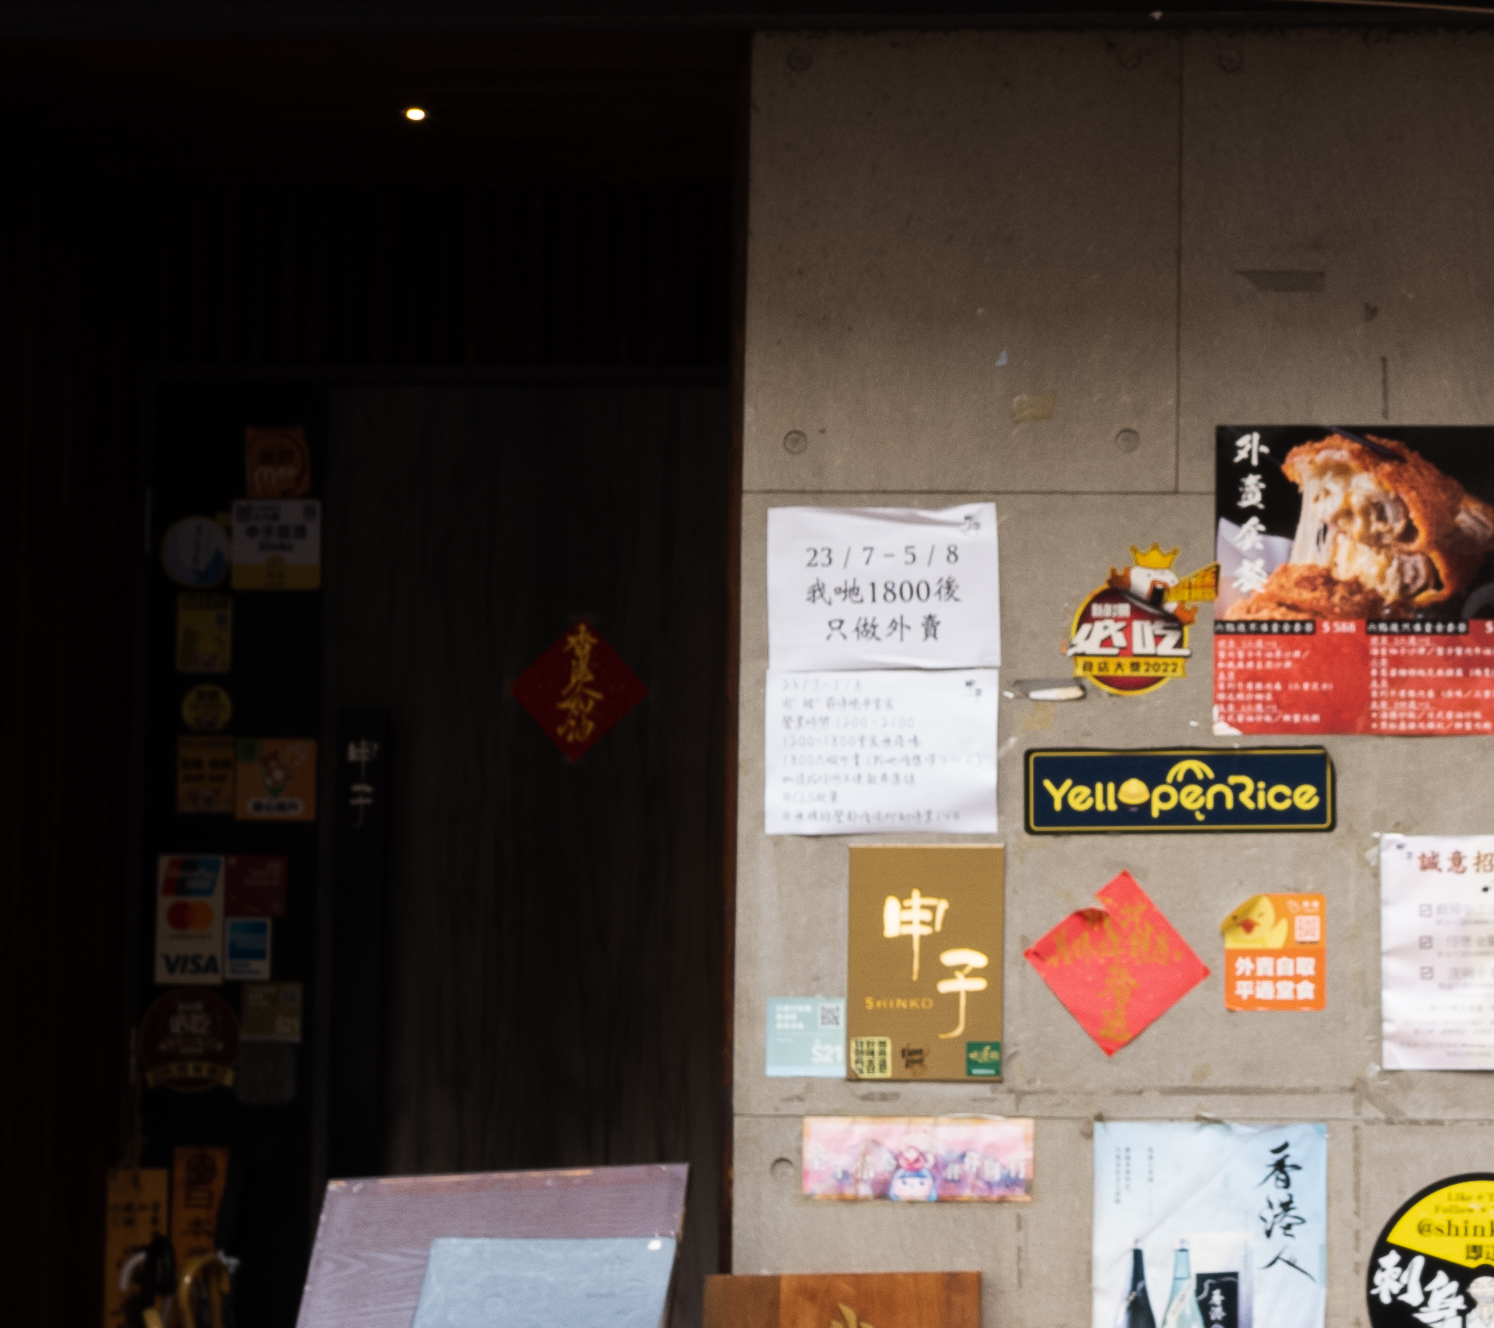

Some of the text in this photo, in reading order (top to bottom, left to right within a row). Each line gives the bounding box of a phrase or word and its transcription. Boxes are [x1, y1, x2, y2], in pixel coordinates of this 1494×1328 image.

[805, 575, 961, 606] 我哋1800後
[825, 612, 941, 642] 只做外賣
[1067, 618, 1193, 658] 必吃
[162, 953, 220, 976] VISA
[883, 887, 990, 1039] 申子
[1234, 956, 1316, 977] 外賣自取
[1234, 979, 1316, 1001] 平過堂食
[1256, 1139, 1319, 1285] 香港人
